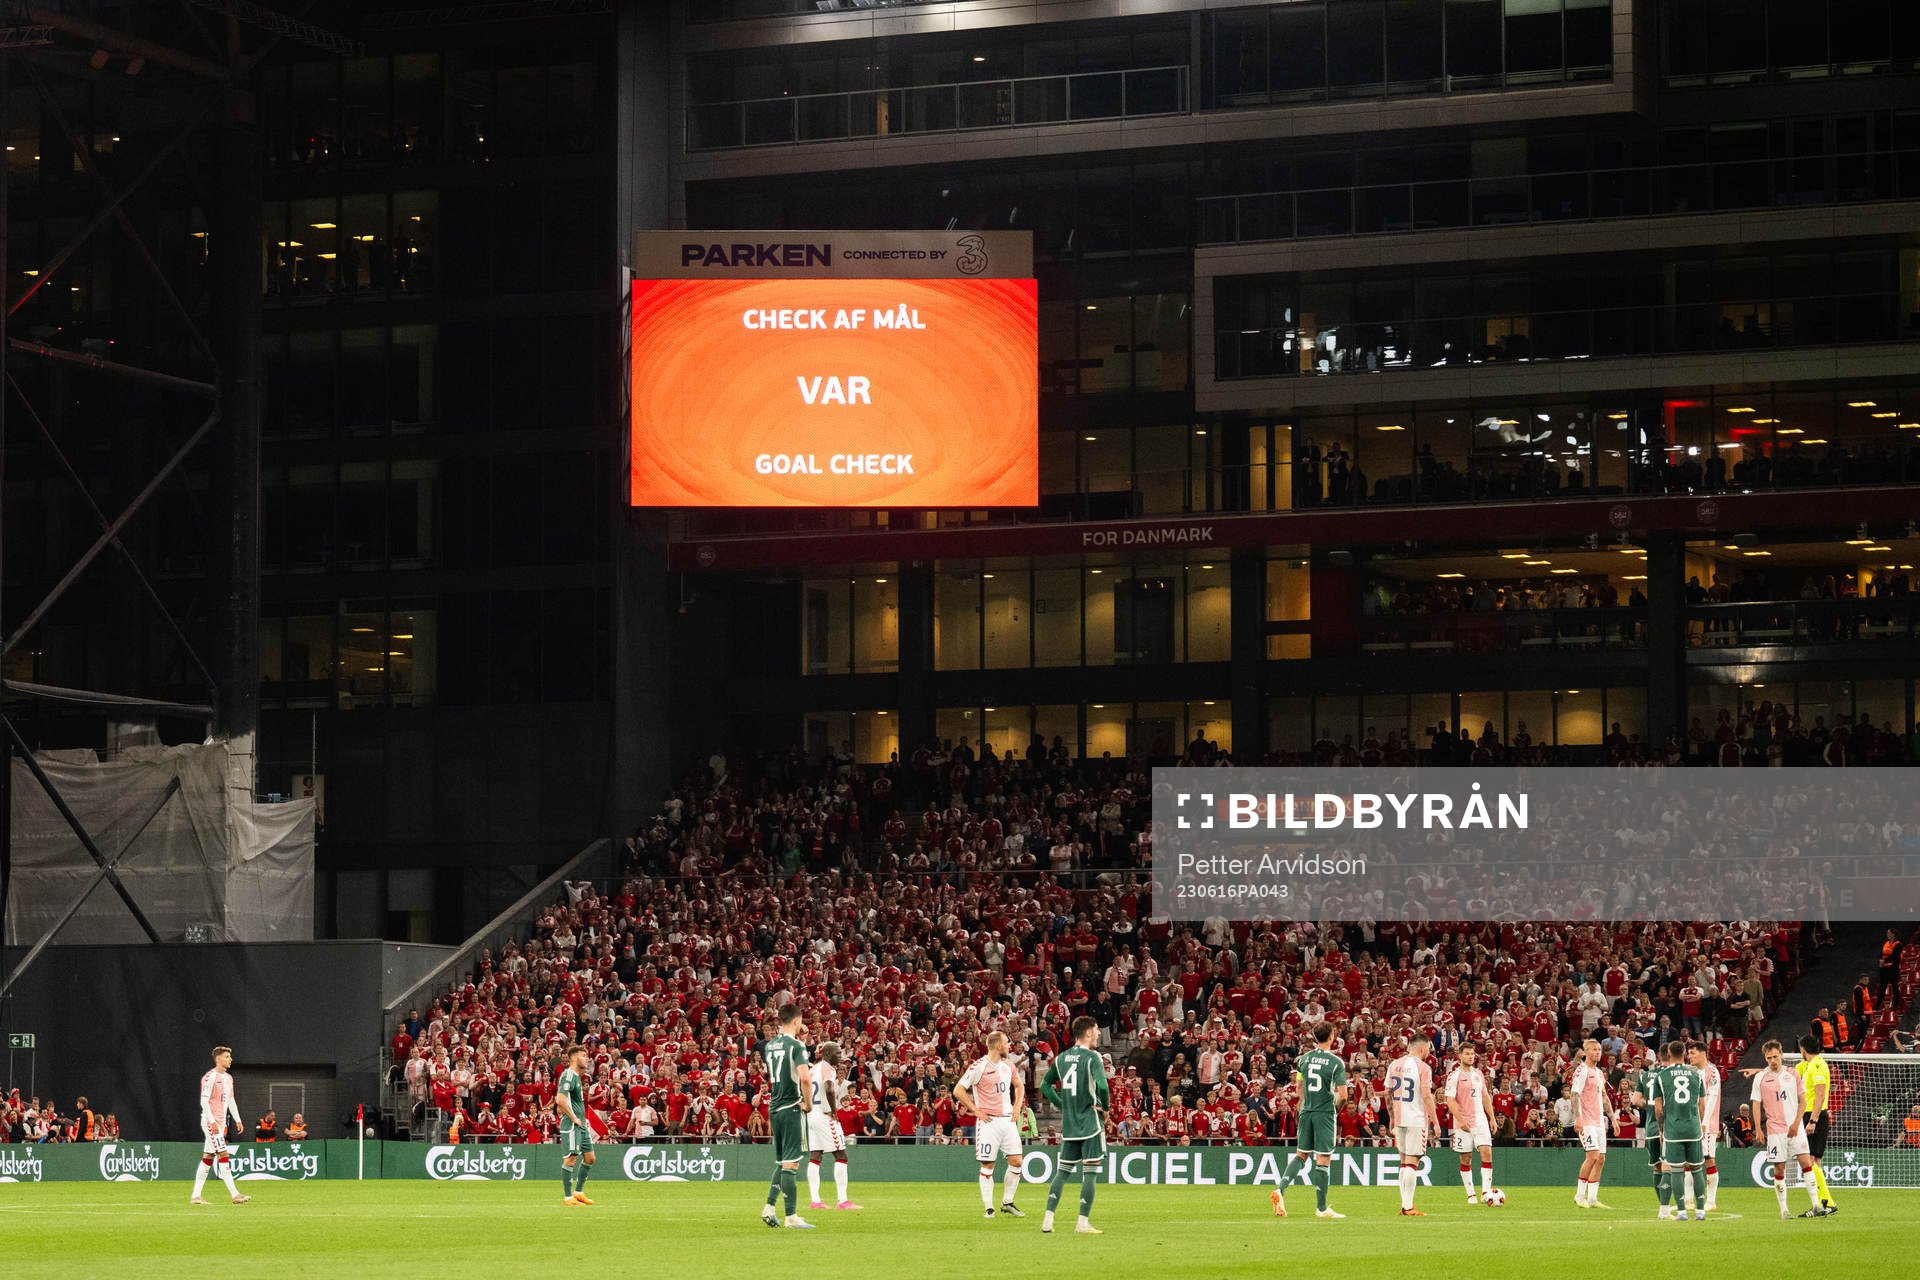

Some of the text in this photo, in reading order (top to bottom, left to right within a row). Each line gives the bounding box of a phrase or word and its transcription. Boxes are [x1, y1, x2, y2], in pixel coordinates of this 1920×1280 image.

[681, 244, 831, 267] PARKEN
[843, 250, 925, 260] CONNECTED
[930, 250, 947, 260] BY
[743, 303, 926, 330] CHECK AF MÅL
[797, 376, 872, 405] VAR
[755, 454, 914, 475] GOAL CHECK
[1083, 527, 1214, 547] FOR DANMARK
[766, 1050, 785, 1083] 17
[1063, 1064, 1077, 1096] 4
[1308, 1064, 1322, 1092] 5
[995, 1082, 1006, 1093] 10
[1390, 1076, 1415, 1102] 23
[1471, 1089, 1476, 1097] 2
[1673, 1076, 1690, 1104] 8
[1775, 1090, 1787, 1101] 14
[980, 1143, 992, 1155] 10
[1457, 1137, 1463, 1147] 2
[1586, 1135, 1592, 1145] 4
[0, 1150, 42, 1182] lsberg
[100, 1144, 160, 1181] Carlsberg
[425, 1146, 527, 1180] Carlsberg
[623, 1146, 725, 1181] Carlsberg
[1022, 1151, 1216, 1185] OICIEL
